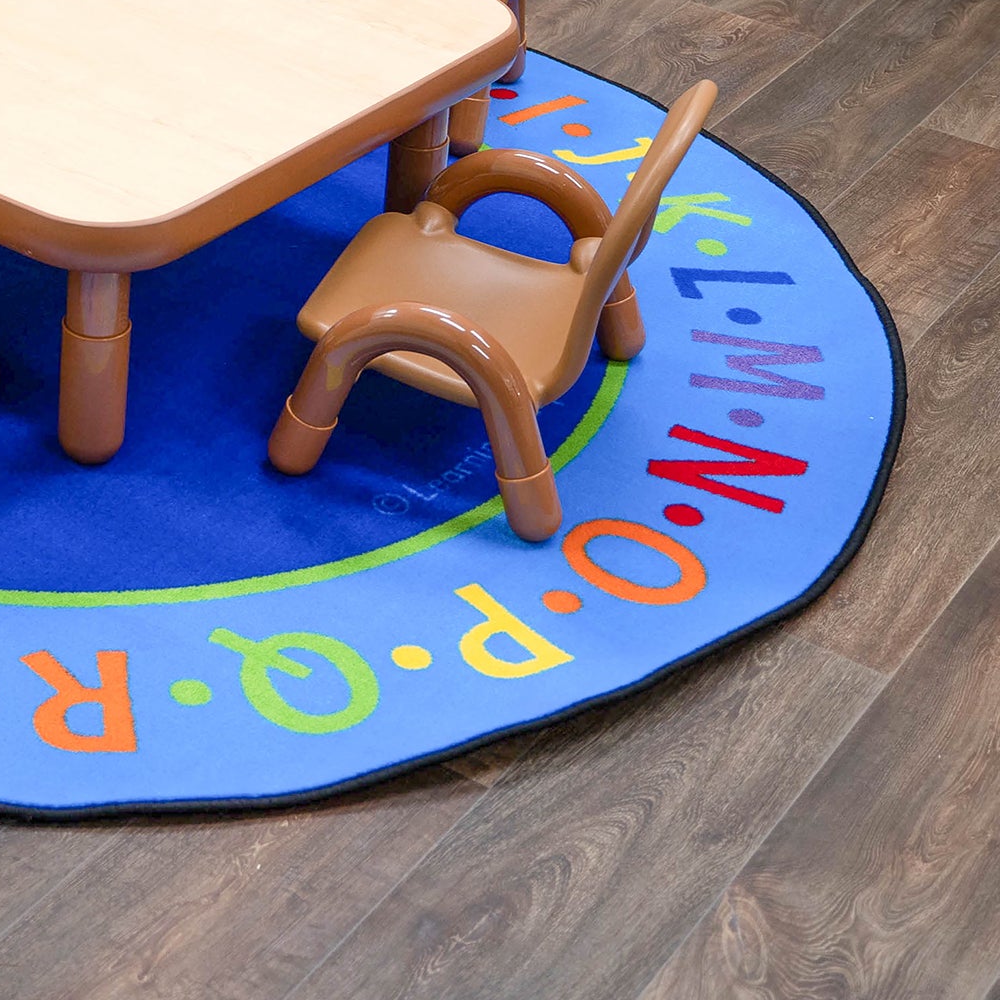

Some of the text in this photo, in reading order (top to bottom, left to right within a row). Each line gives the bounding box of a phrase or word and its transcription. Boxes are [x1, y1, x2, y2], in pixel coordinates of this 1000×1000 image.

[670, 267, 796, 299] L
[689, 329, 825, 401] M
[647, 424, 809, 514] N
[562, 518, 707, 605] O
[453, 583, 575, 679] P
[20, 650, 137, 752] R
[208, 627, 380, 735] Q
